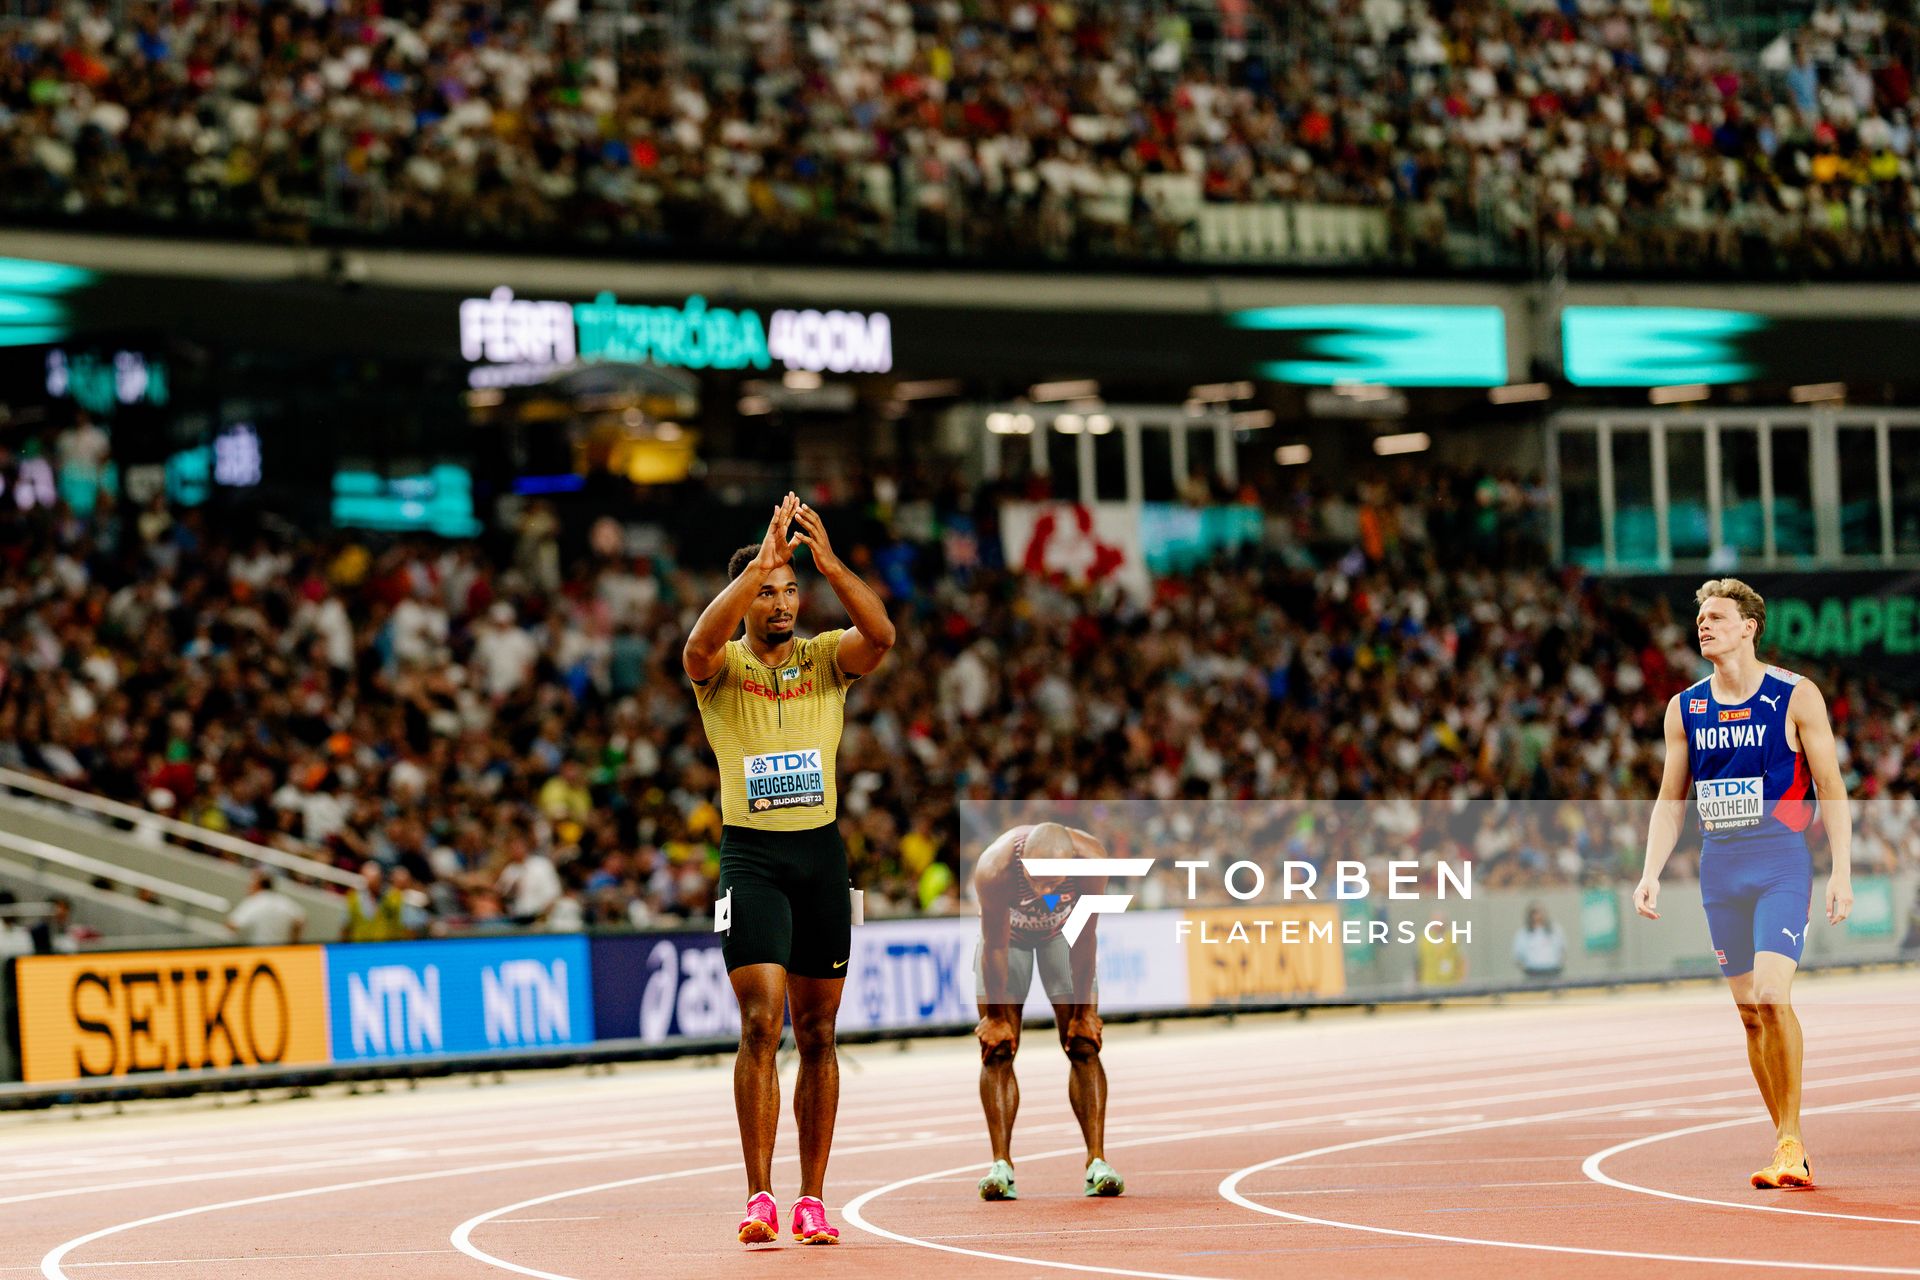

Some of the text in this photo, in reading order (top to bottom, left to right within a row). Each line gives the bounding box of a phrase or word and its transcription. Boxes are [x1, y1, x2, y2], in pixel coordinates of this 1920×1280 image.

[768, 309, 892, 373] 400M
[742, 679, 813, 702] GERMANY
[1695, 724, 1767, 750] NORWAY
[766, 752, 817, 771] TDK
[749, 773, 821, 797] NEUGEBAUER
[1709, 780, 1757, 797] TDK
[1700, 798, 1759, 818] SKOTHEIM
[1715, 819, 1750, 830] BUDAPEST
[348, 964, 443, 1056] NTN
[482, 958, 571, 1048] NTN
[72, 962, 289, 1078] SEIKO
